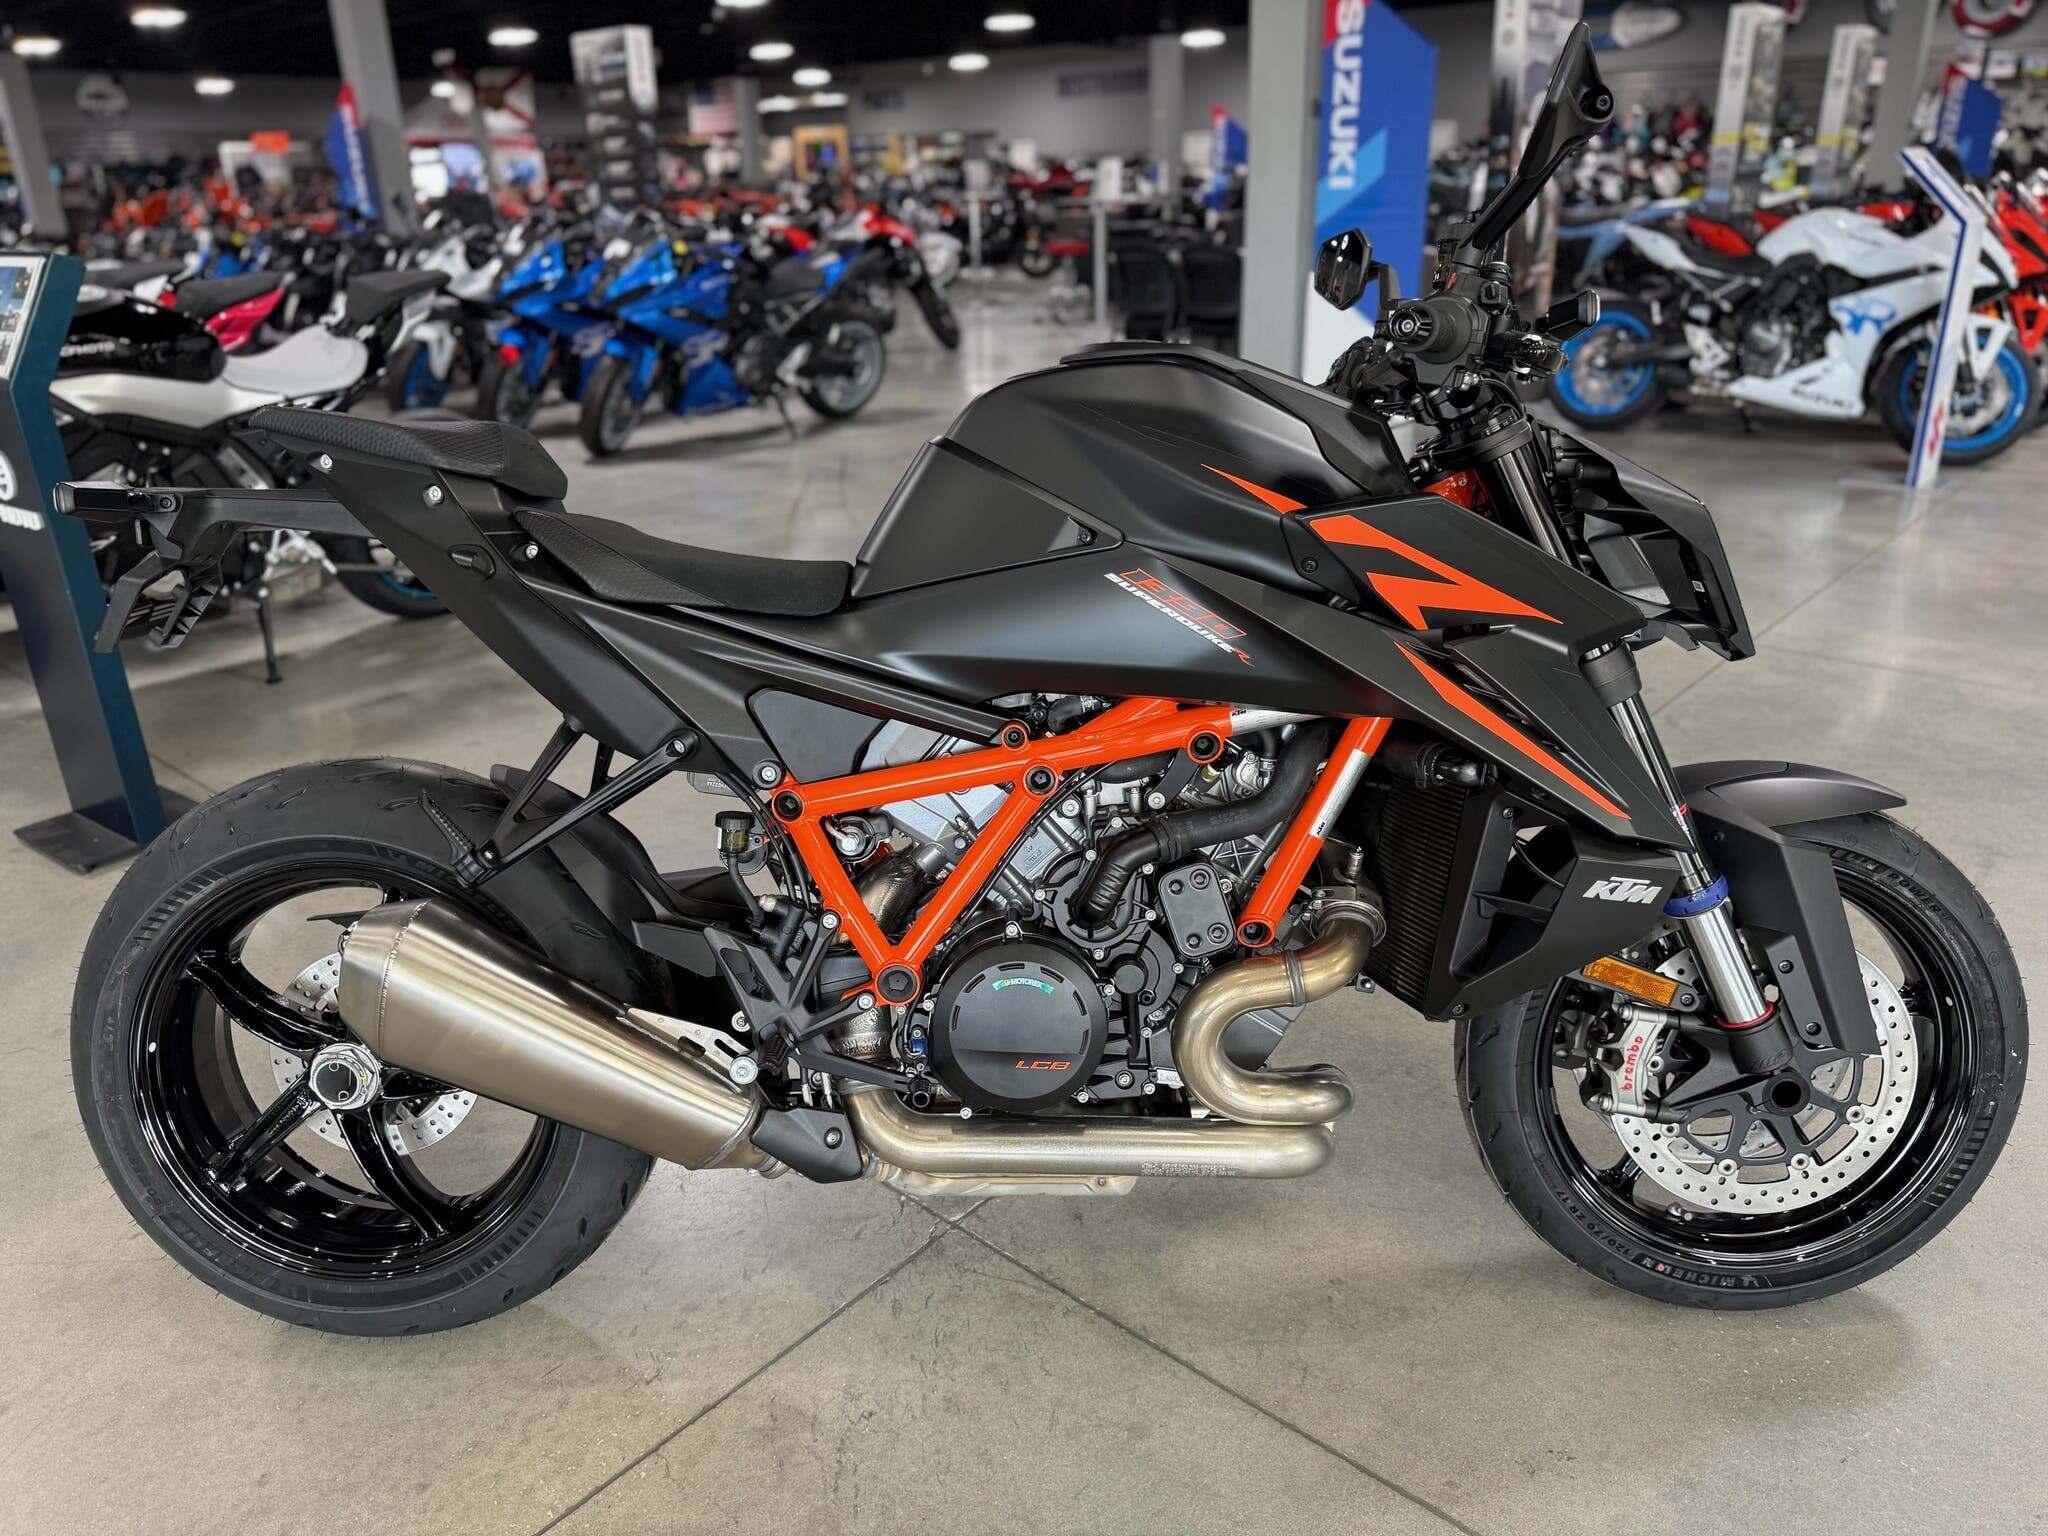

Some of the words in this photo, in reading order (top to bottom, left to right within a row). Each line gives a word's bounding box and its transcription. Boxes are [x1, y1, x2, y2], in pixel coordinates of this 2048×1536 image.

[1328, 0, 1366, 190] SUZUKI
[1582, 876, 1663, 904] KTM
[1010, 977, 1042, 988] MOTOREX
[1619, 1035, 1644, 1092] brembo
[1556, 1190, 1569, 1204] 17
[1569, 1205, 1587, 1221] ZR
[1586, 1222, 1634, 1256] 120/70
